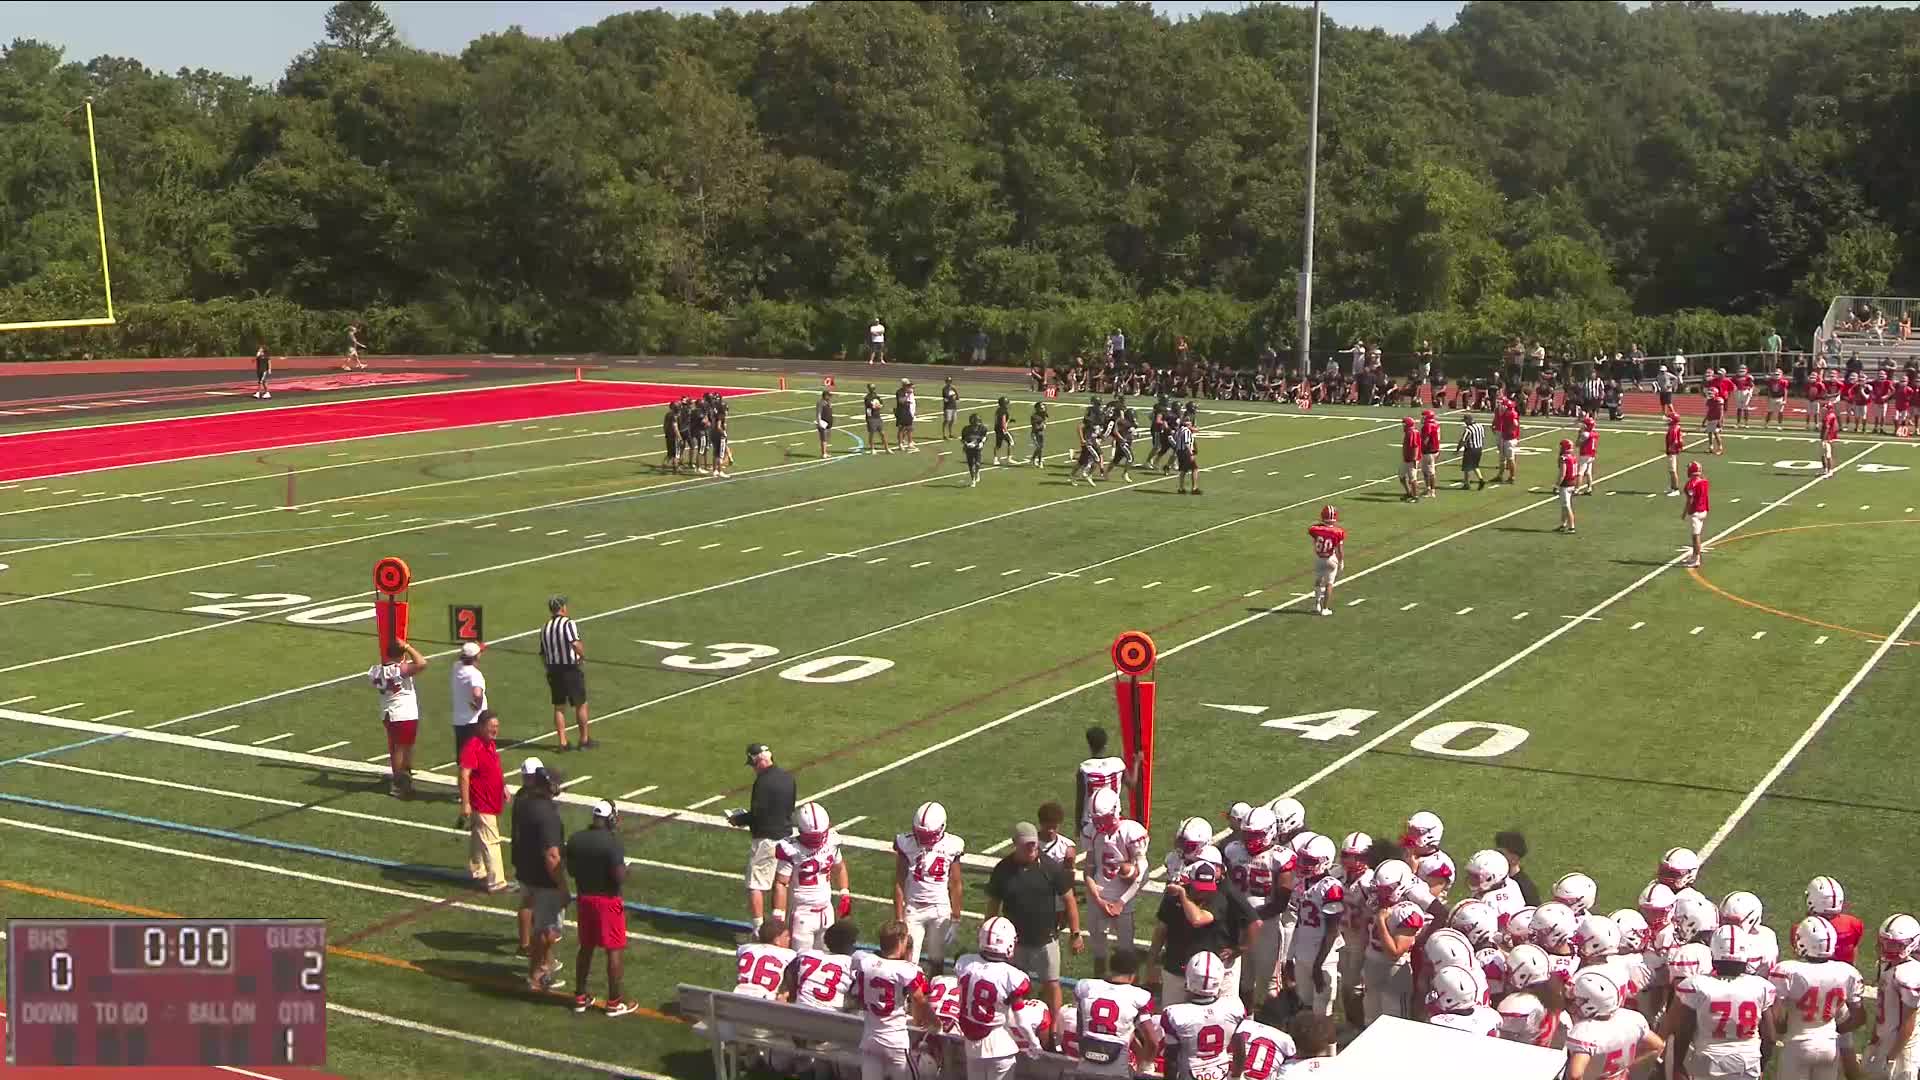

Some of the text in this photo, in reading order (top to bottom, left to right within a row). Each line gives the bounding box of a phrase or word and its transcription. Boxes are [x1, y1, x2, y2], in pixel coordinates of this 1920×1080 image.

[1046, 388, 1055, 397] 10
[1895, 426, 1907, 437] 40
[459, 608, 478, 638] 2
[1495, 893, 1509, 901] 65
[737, 951, 783, 992] 26
[800, 955, 843, 1002] 73
[960, 974, 998, 1024] 18
[1090, 997, 1119, 1035] 8
[1796, 986, 1845, 1023] 40
[1710, 1001, 1758, 1040] 78
[1197, 1024, 1225, 1060] 9
